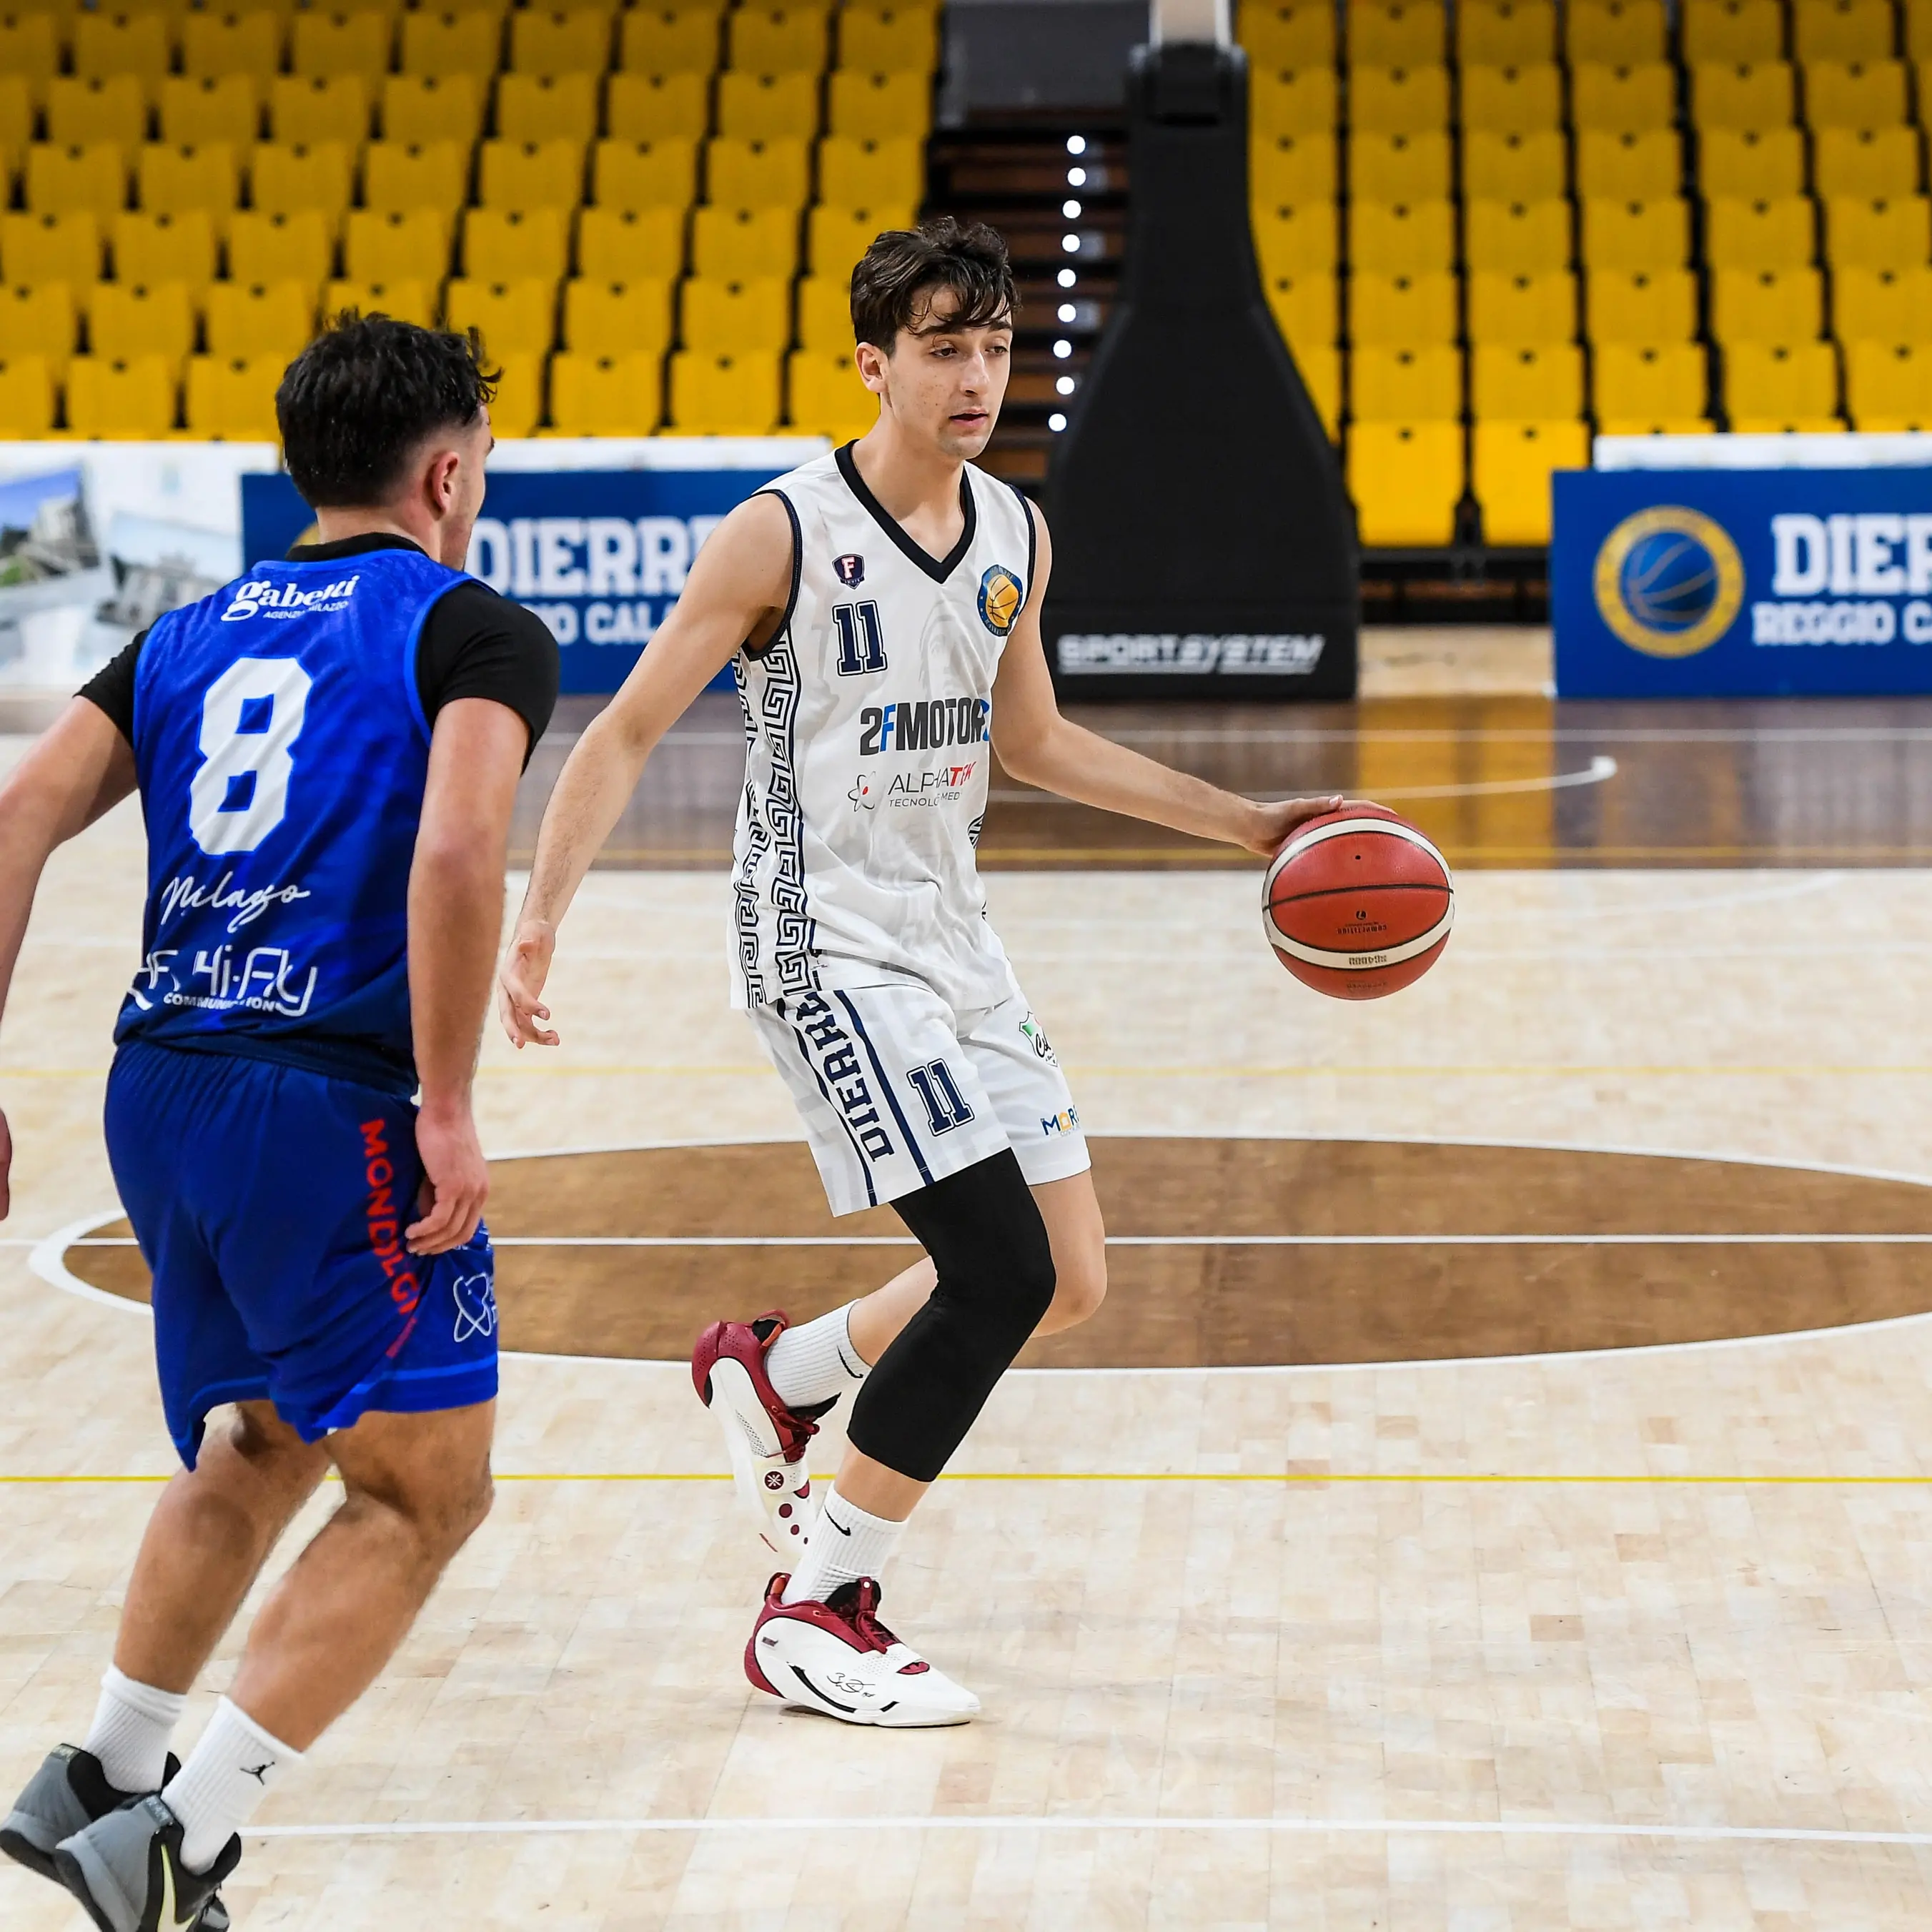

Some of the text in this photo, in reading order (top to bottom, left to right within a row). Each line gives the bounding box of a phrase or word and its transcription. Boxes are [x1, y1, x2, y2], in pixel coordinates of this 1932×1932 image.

[585, 602, 676, 645] CAL
[833, 600, 888, 676] 11
[188, 657, 313, 856] 8
[906, 1059, 974, 1137] 11
